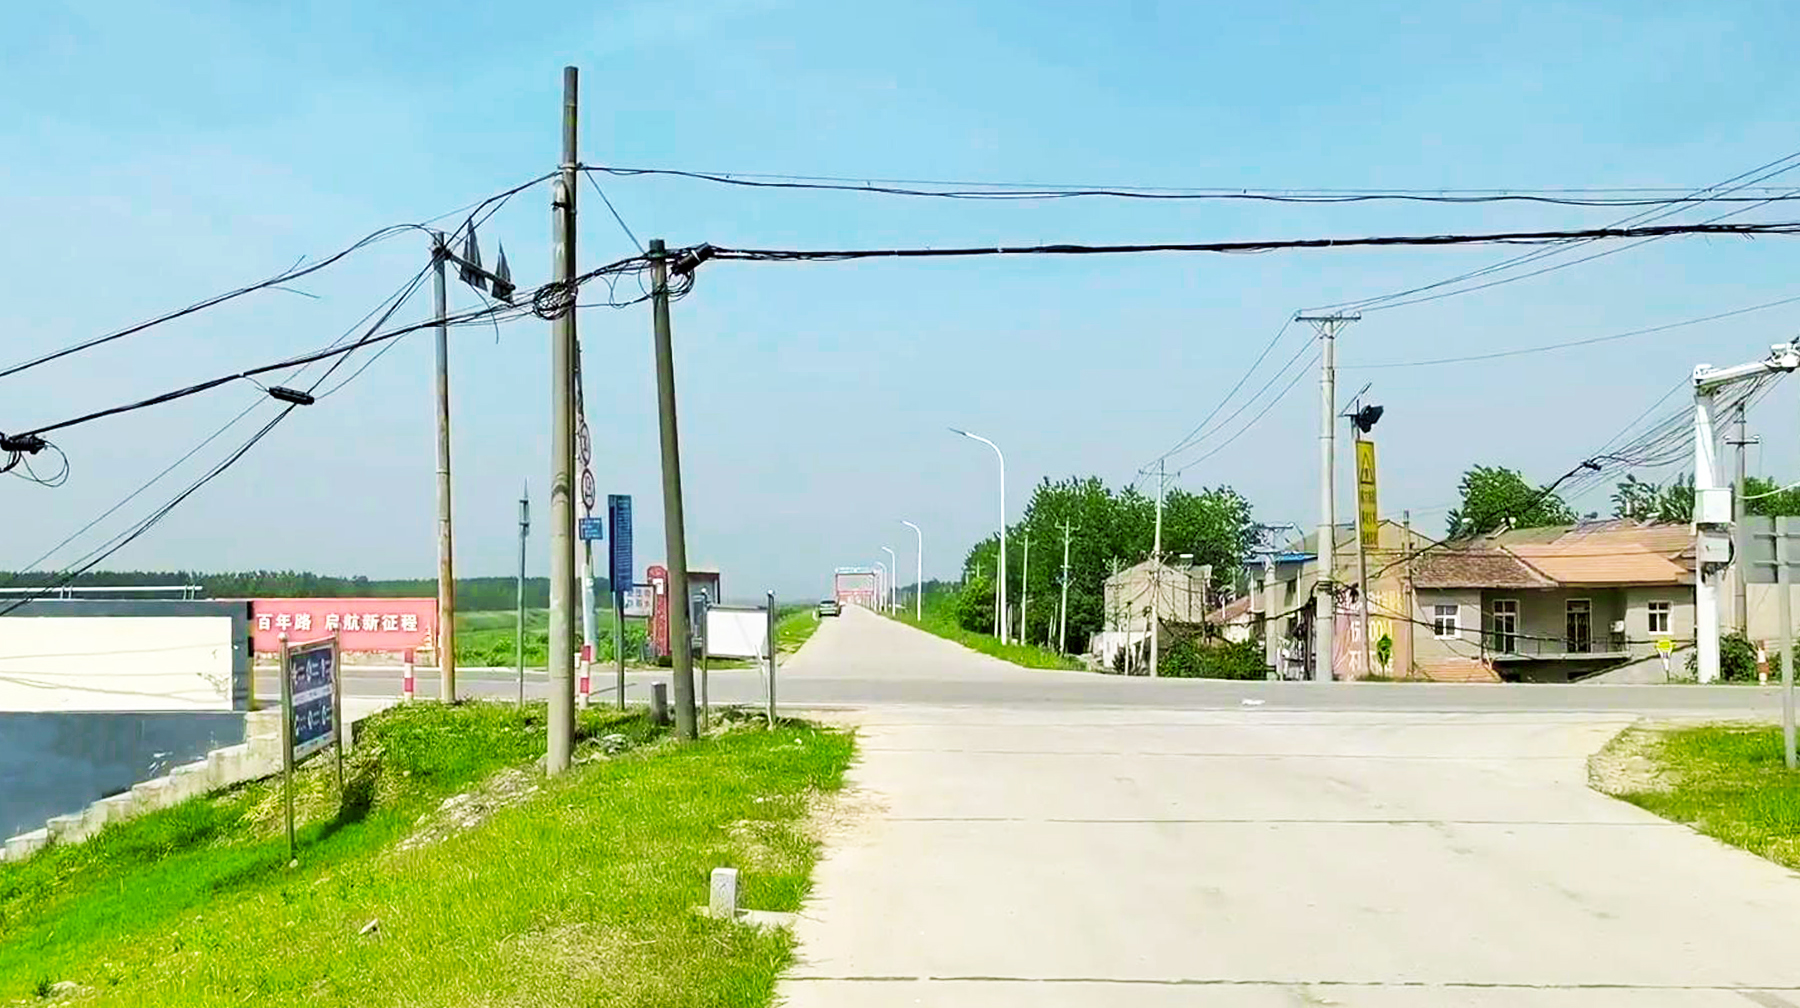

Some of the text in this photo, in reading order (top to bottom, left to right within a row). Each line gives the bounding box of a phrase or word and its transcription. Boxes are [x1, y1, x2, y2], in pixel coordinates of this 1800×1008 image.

[256, 613, 418, 632] 百年路 启航新征程
